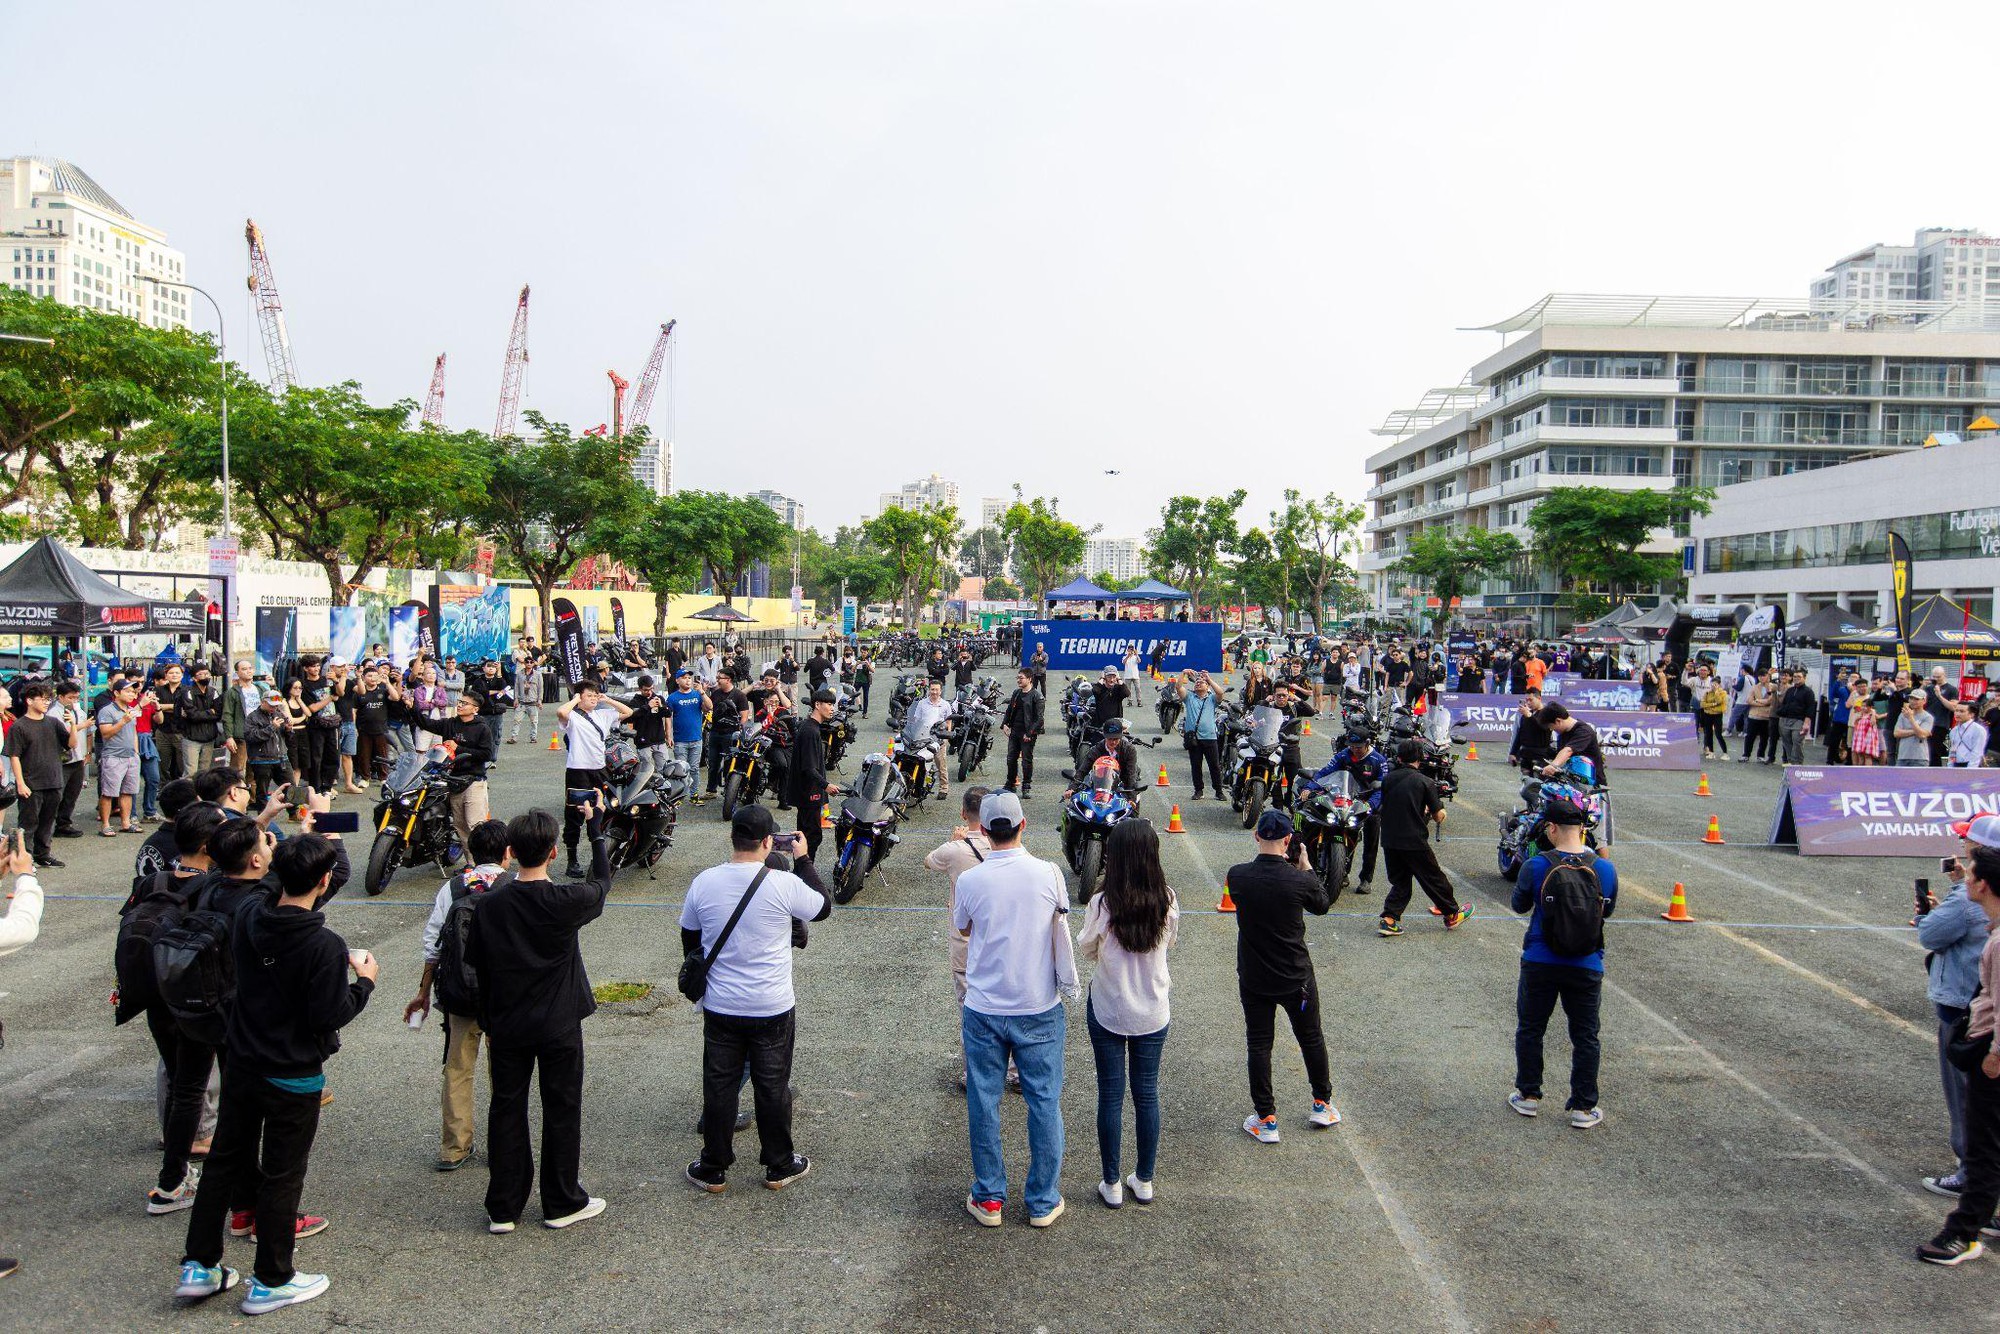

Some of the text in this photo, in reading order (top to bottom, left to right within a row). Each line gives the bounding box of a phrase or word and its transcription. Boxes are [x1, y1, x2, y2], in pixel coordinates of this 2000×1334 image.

[1950, 237, 1967, 246] THE
[1950, 508, 2000, 534] Fulbrigh
[261, 595, 274, 606] C10
[276, 596, 308, 606] CULTURAL
[153, 607, 193, 619] REVZONE
[1060, 638, 1187, 656] TECHNICAL AEA
[1940, 648, 1990, 657] AUTHRIZED
[1617, 748, 1661, 757] MOTOR
[1841, 791, 2000, 819] REVZON
[1862, 822, 1943, 837] YAMAHA
